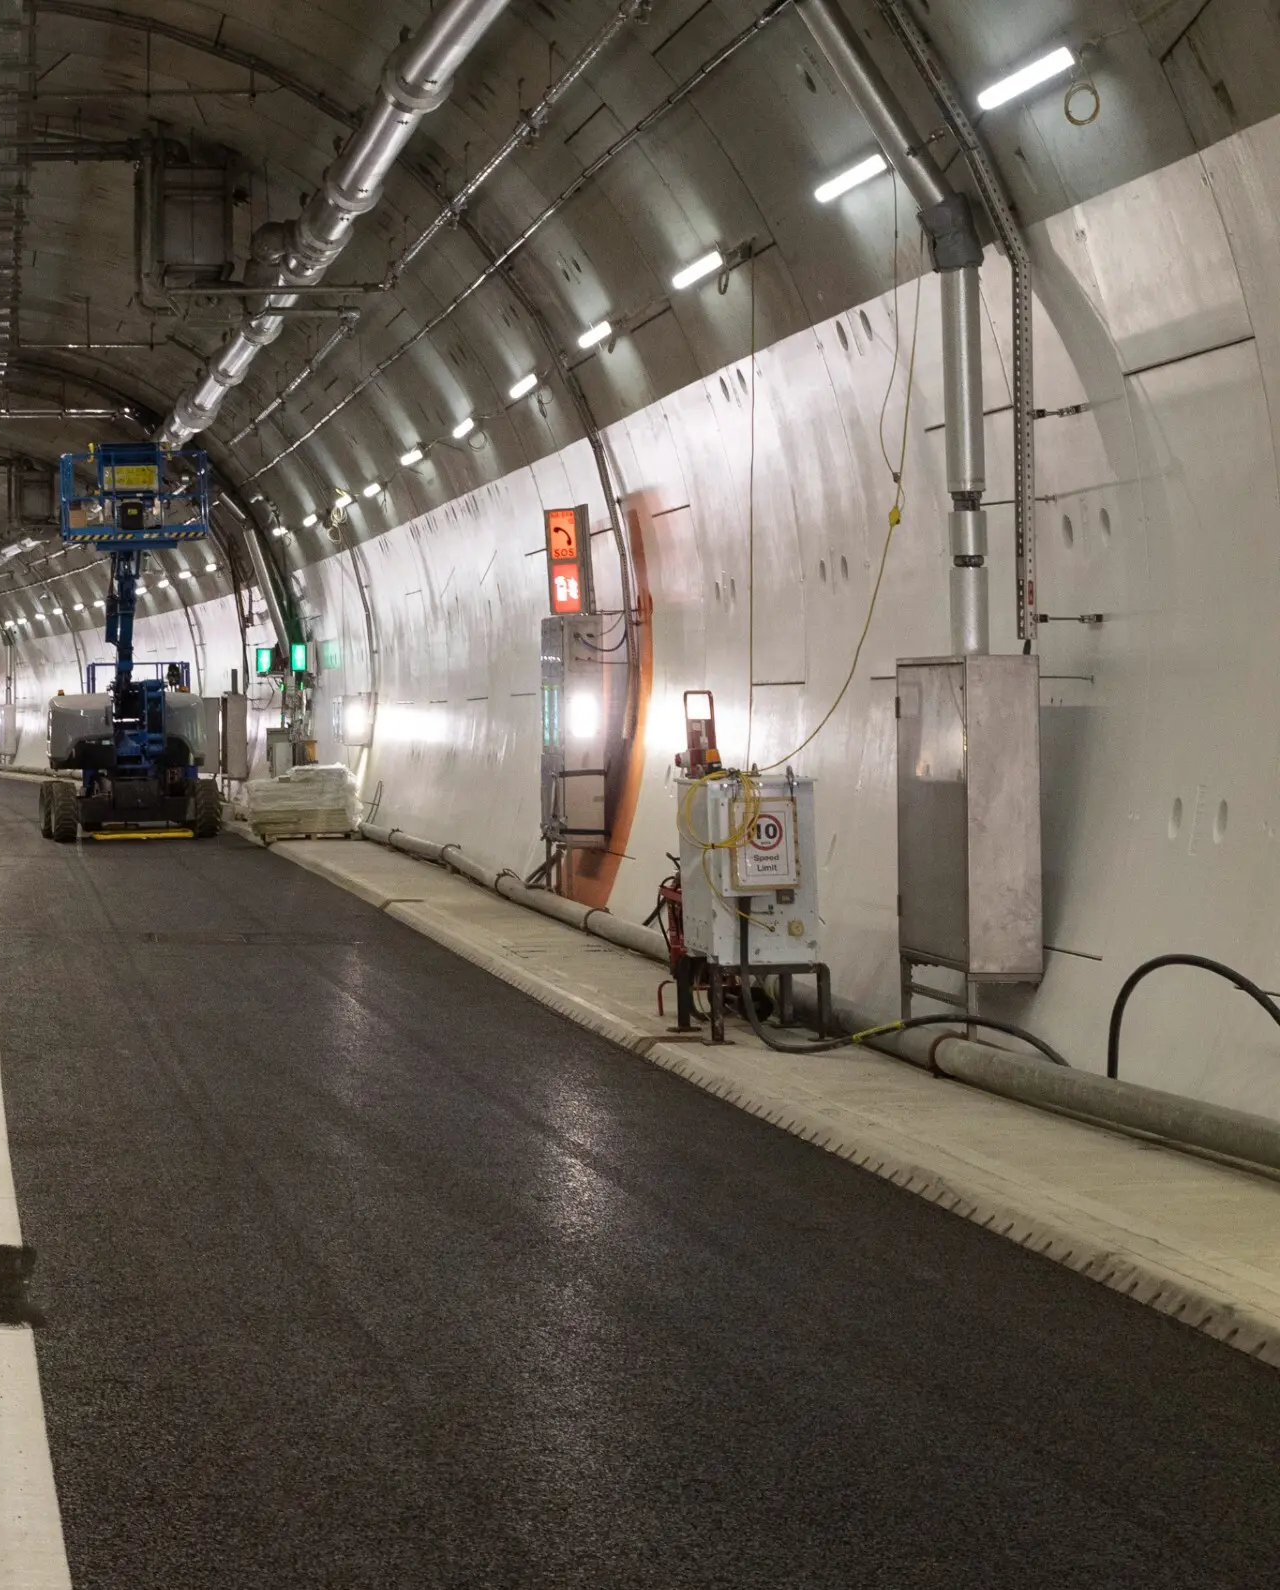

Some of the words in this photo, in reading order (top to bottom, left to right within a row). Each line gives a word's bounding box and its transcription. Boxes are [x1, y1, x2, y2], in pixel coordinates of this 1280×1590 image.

[553, 548, 574, 558] SOS
[756, 823, 778, 840] 10
[753, 854, 780, 862] Speed
[756, 864, 778, 872] Limit
